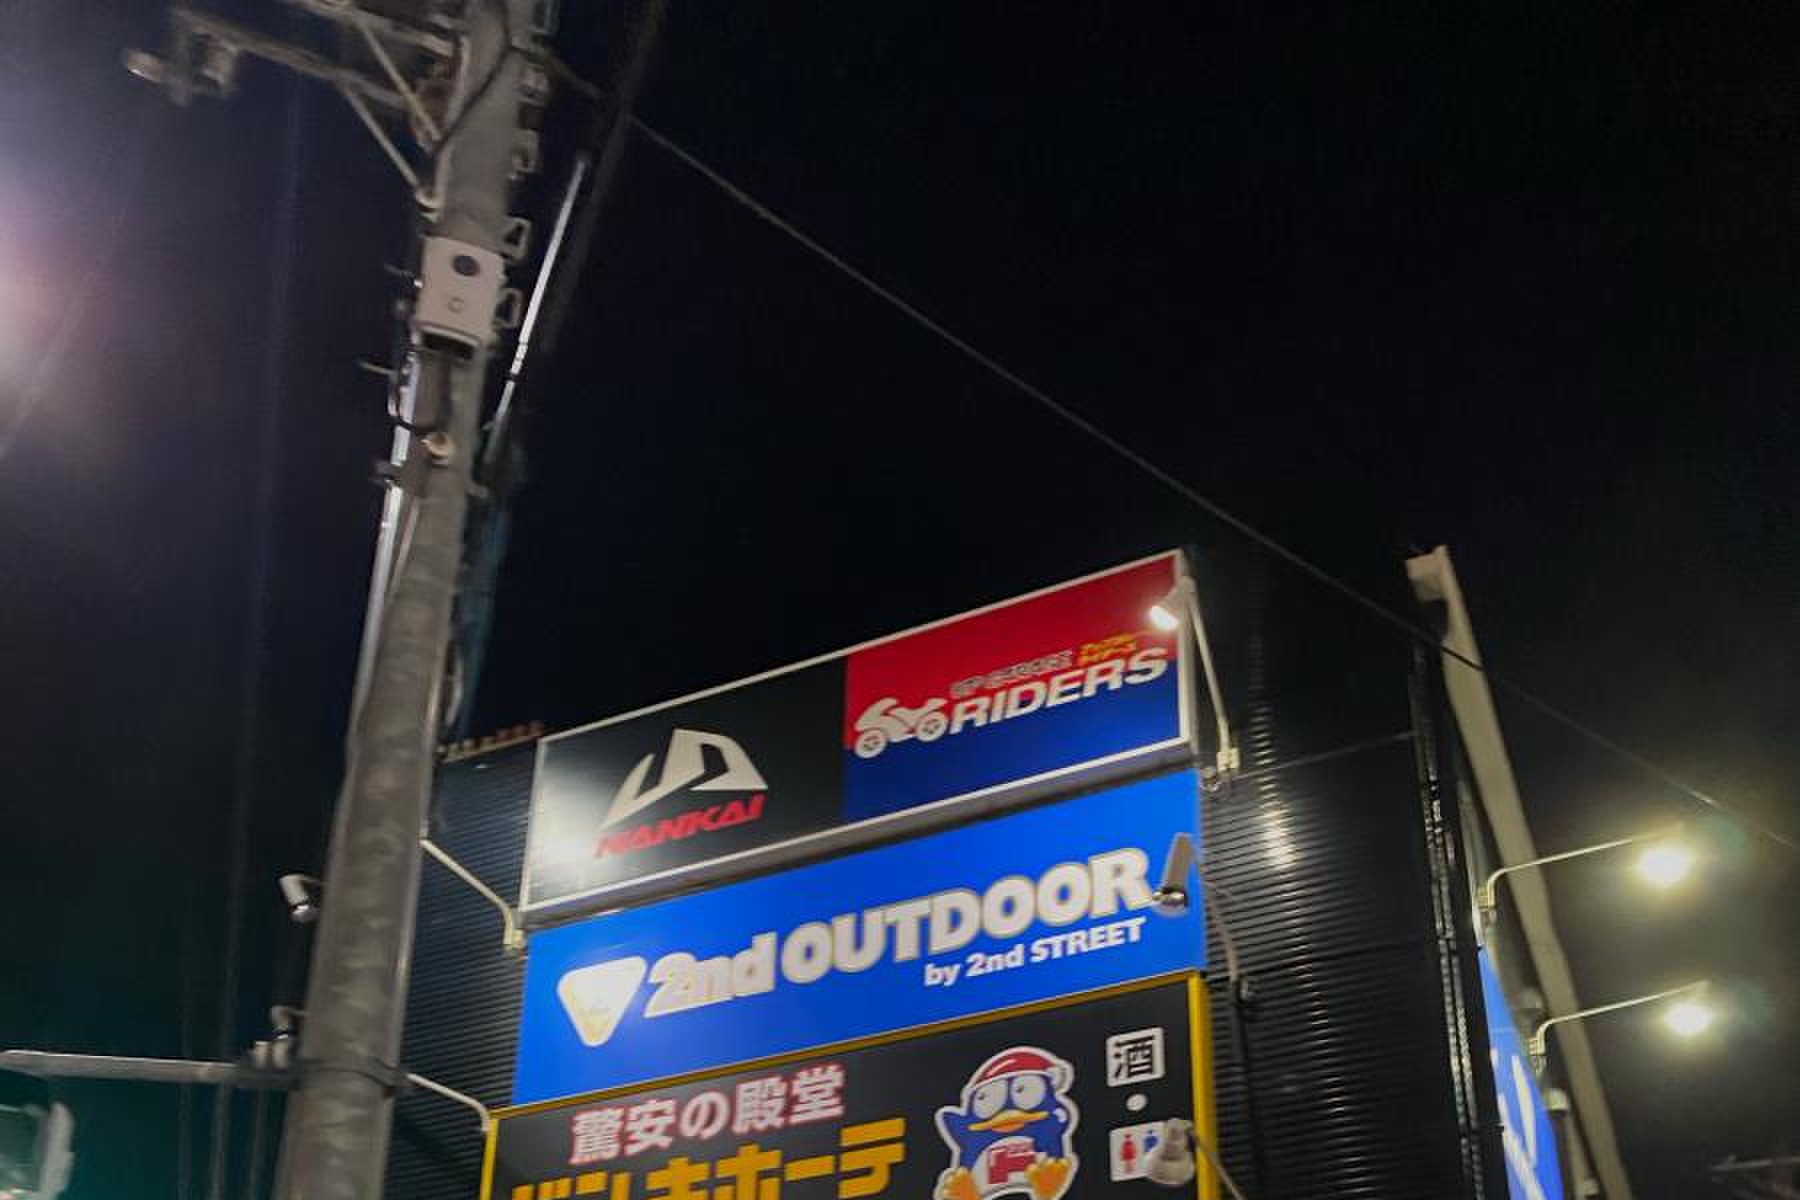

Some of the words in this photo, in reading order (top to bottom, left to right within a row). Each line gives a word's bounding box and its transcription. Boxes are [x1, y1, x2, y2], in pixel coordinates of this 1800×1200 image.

[949, 647, 1168, 734] RIDERS
[592, 793, 766, 858] NANKAI
[644, 932, 776, 1019] 2nd
[781, 846, 1153, 984] OUTDOOR
[924, 961, 962, 988] by
[966, 944, 1025, 978] 2nd
[1030, 916, 1147, 962] STREET
[1113, 1033, 1156, 1080] 酒
[569, 1062, 846, 1166] 驚安の殿堂
